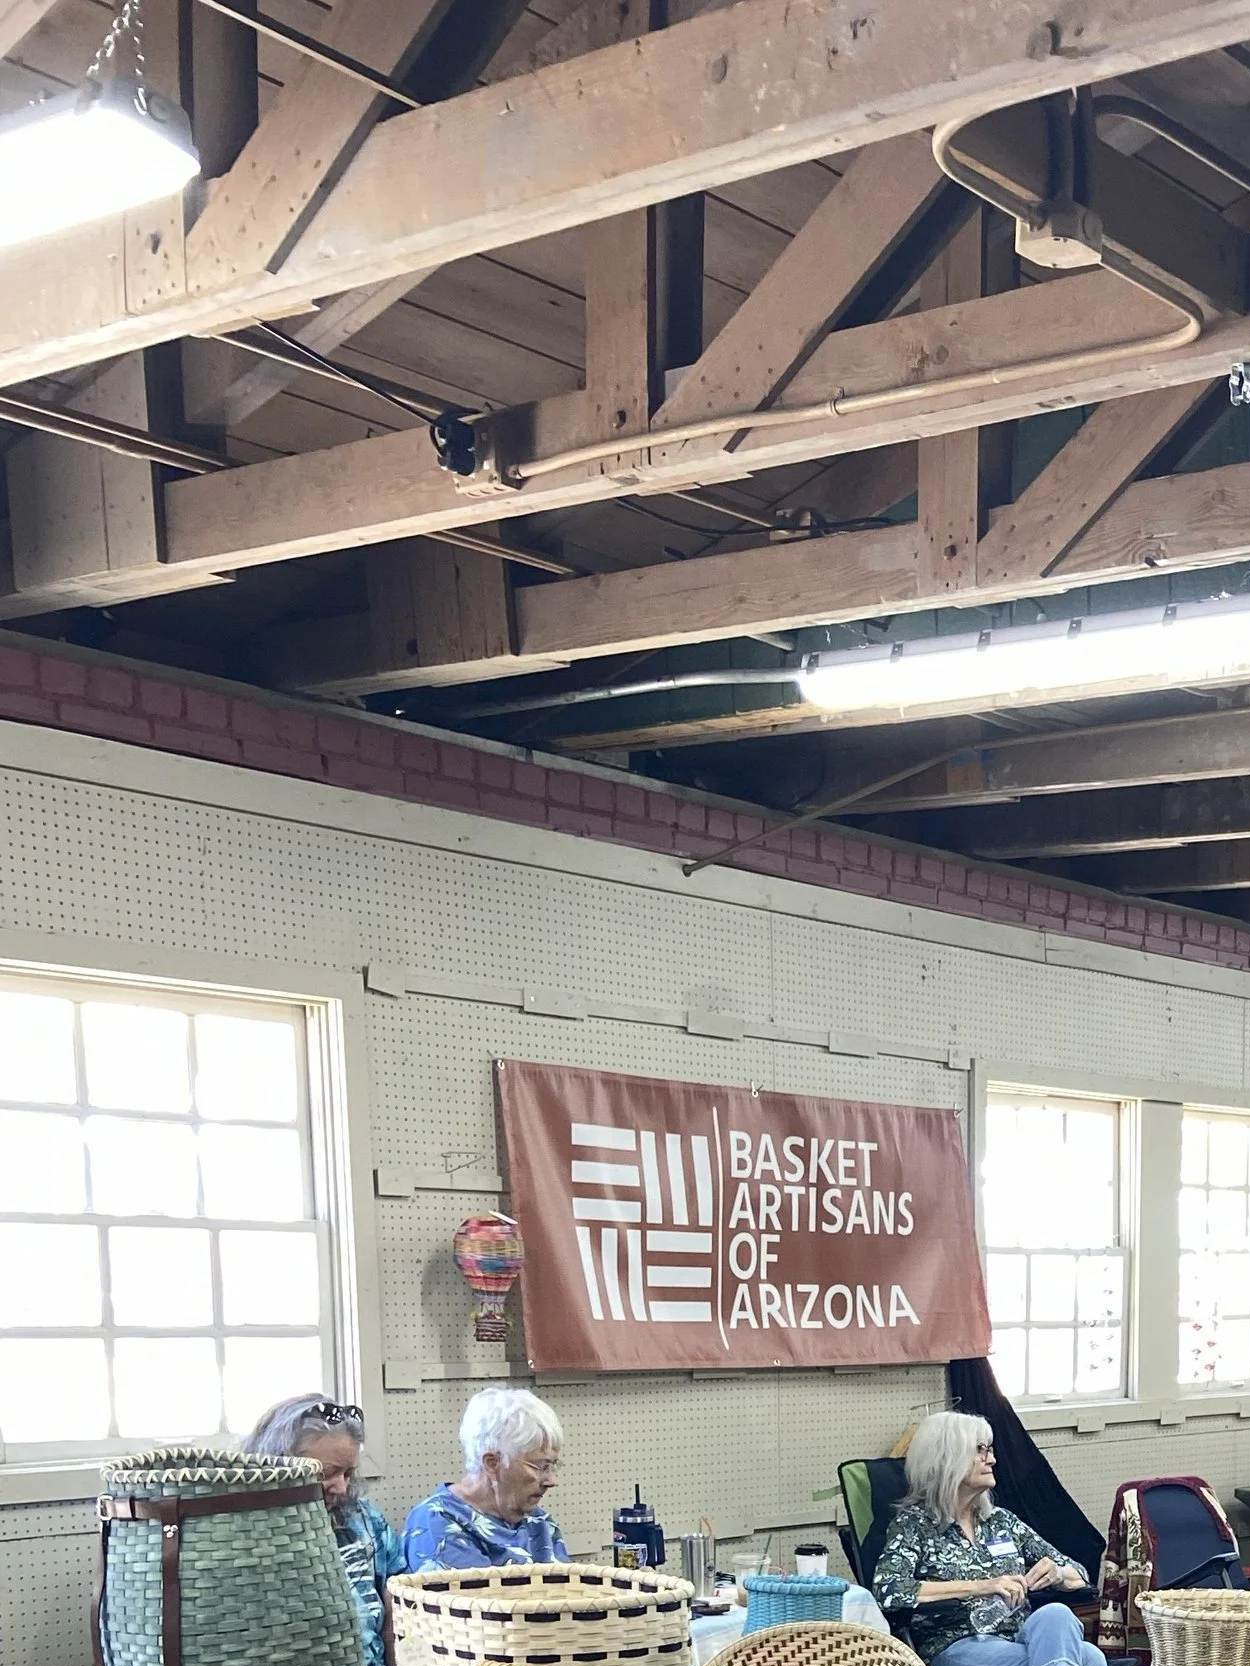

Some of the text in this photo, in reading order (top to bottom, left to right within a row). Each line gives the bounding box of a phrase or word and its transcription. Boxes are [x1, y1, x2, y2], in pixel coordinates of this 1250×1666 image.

[728, 1130, 878, 1187] BASKET
[728, 1182, 915, 1236] ARTISANS
[728, 1231, 780, 1281] OF
[728, 1282, 922, 1330] ARIZONA
